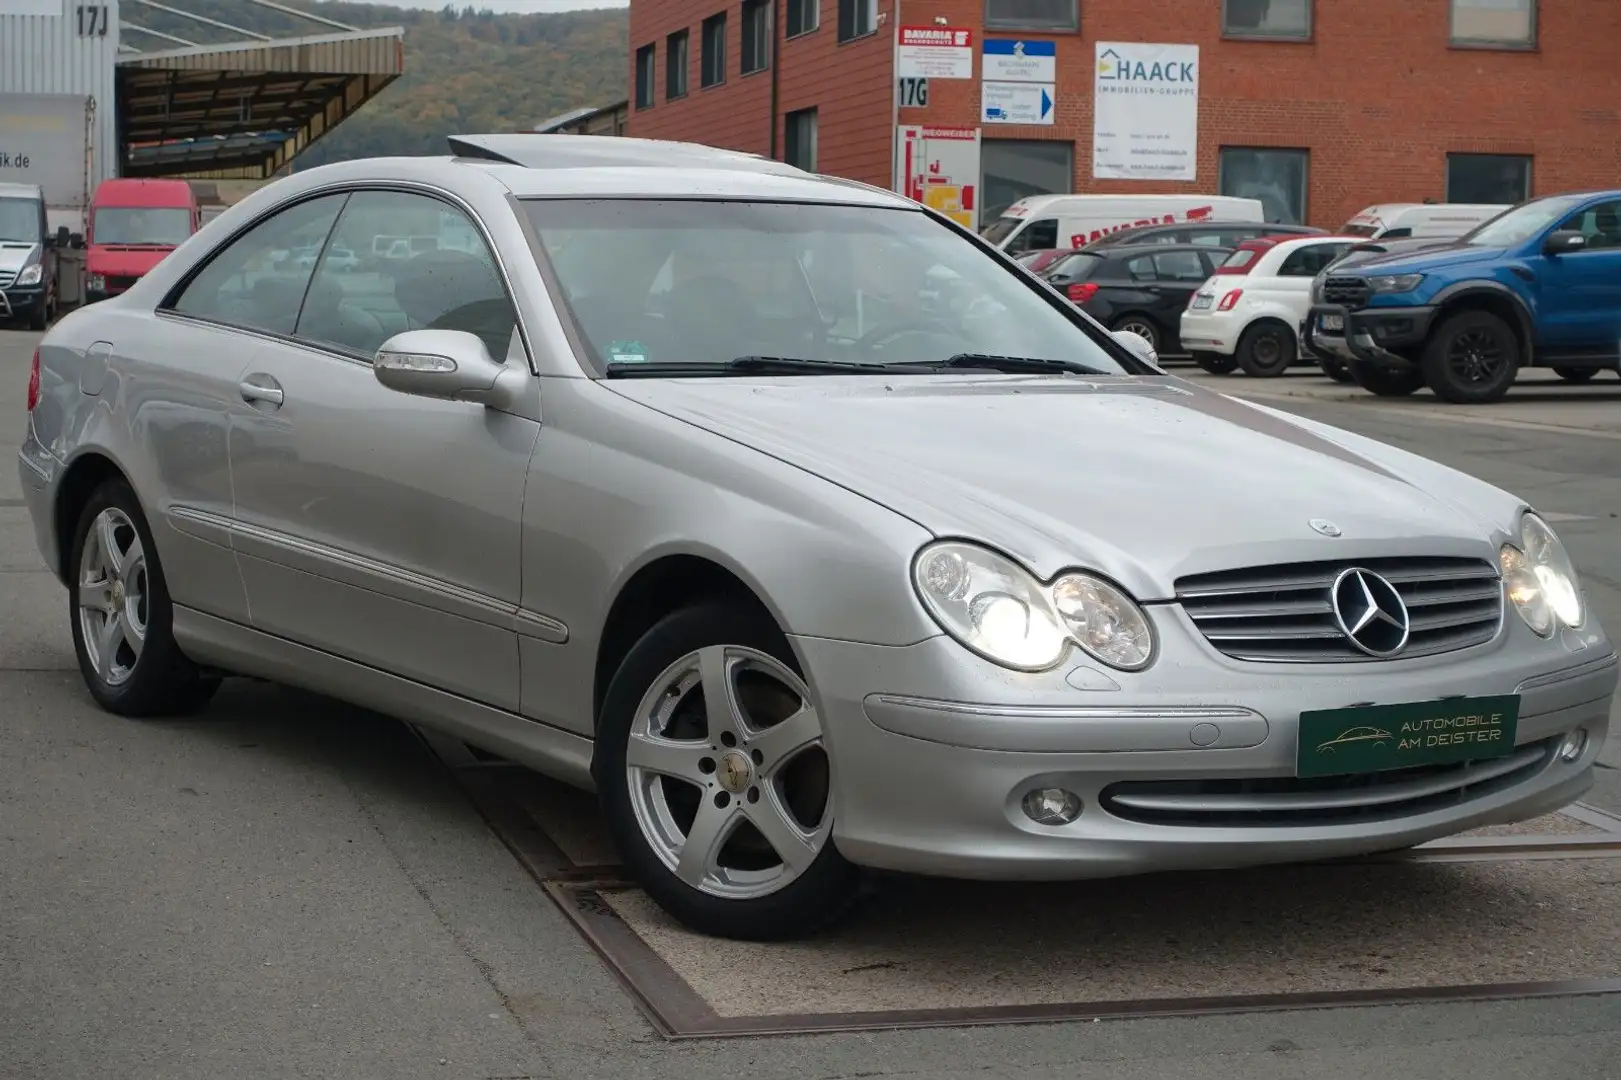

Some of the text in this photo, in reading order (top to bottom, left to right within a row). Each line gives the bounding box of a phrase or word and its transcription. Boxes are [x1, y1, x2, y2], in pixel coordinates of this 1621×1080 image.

[77, 6, 107, 36] 17J
[904, 29, 952, 39] BAVARIA
[1117, 61, 1194, 82] HAACK
[900, 78, 927, 106] 17G
[1401, 713, 1503, 732] AUTOMOBILE
[1398, 729, 1502, 749] AM DEISTER
